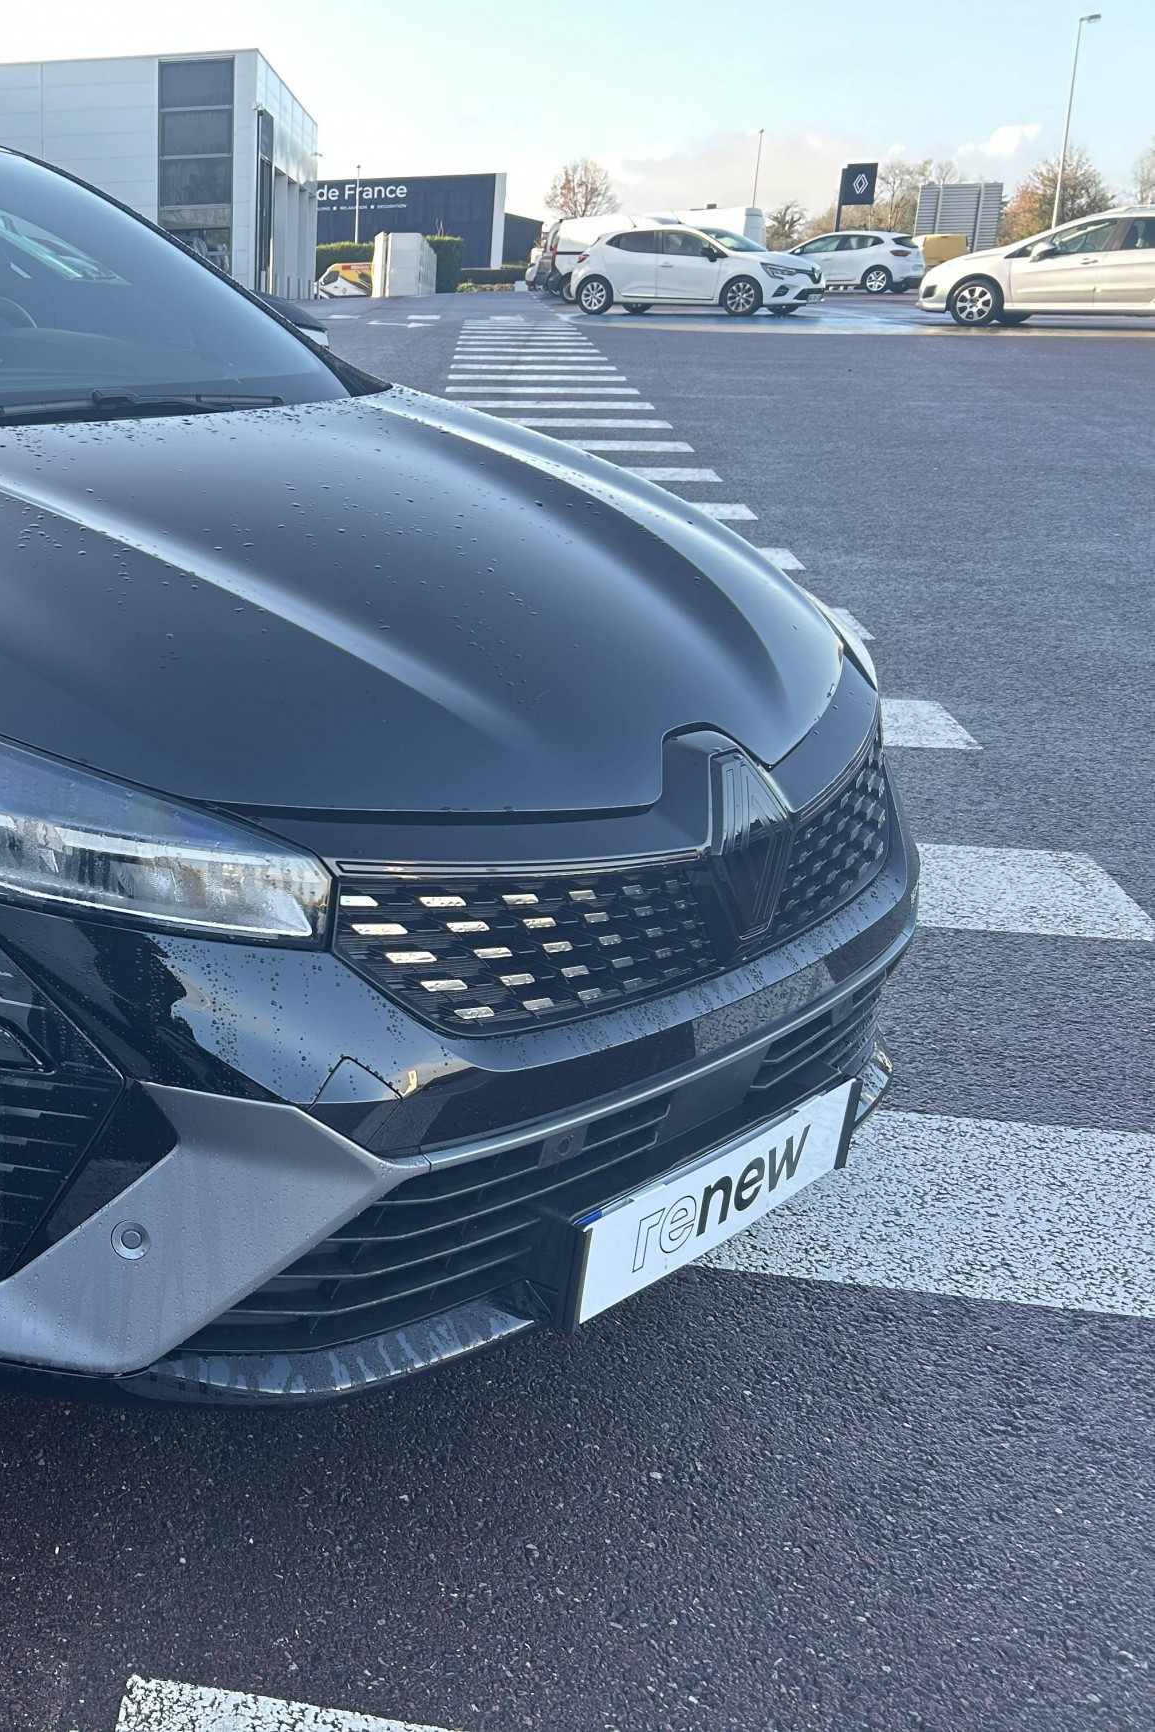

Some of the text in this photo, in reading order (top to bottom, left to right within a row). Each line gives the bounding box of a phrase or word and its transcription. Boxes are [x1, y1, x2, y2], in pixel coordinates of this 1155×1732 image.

[316, 184, 407, 201] de France
[632, 1123, 812, 1274] renew
